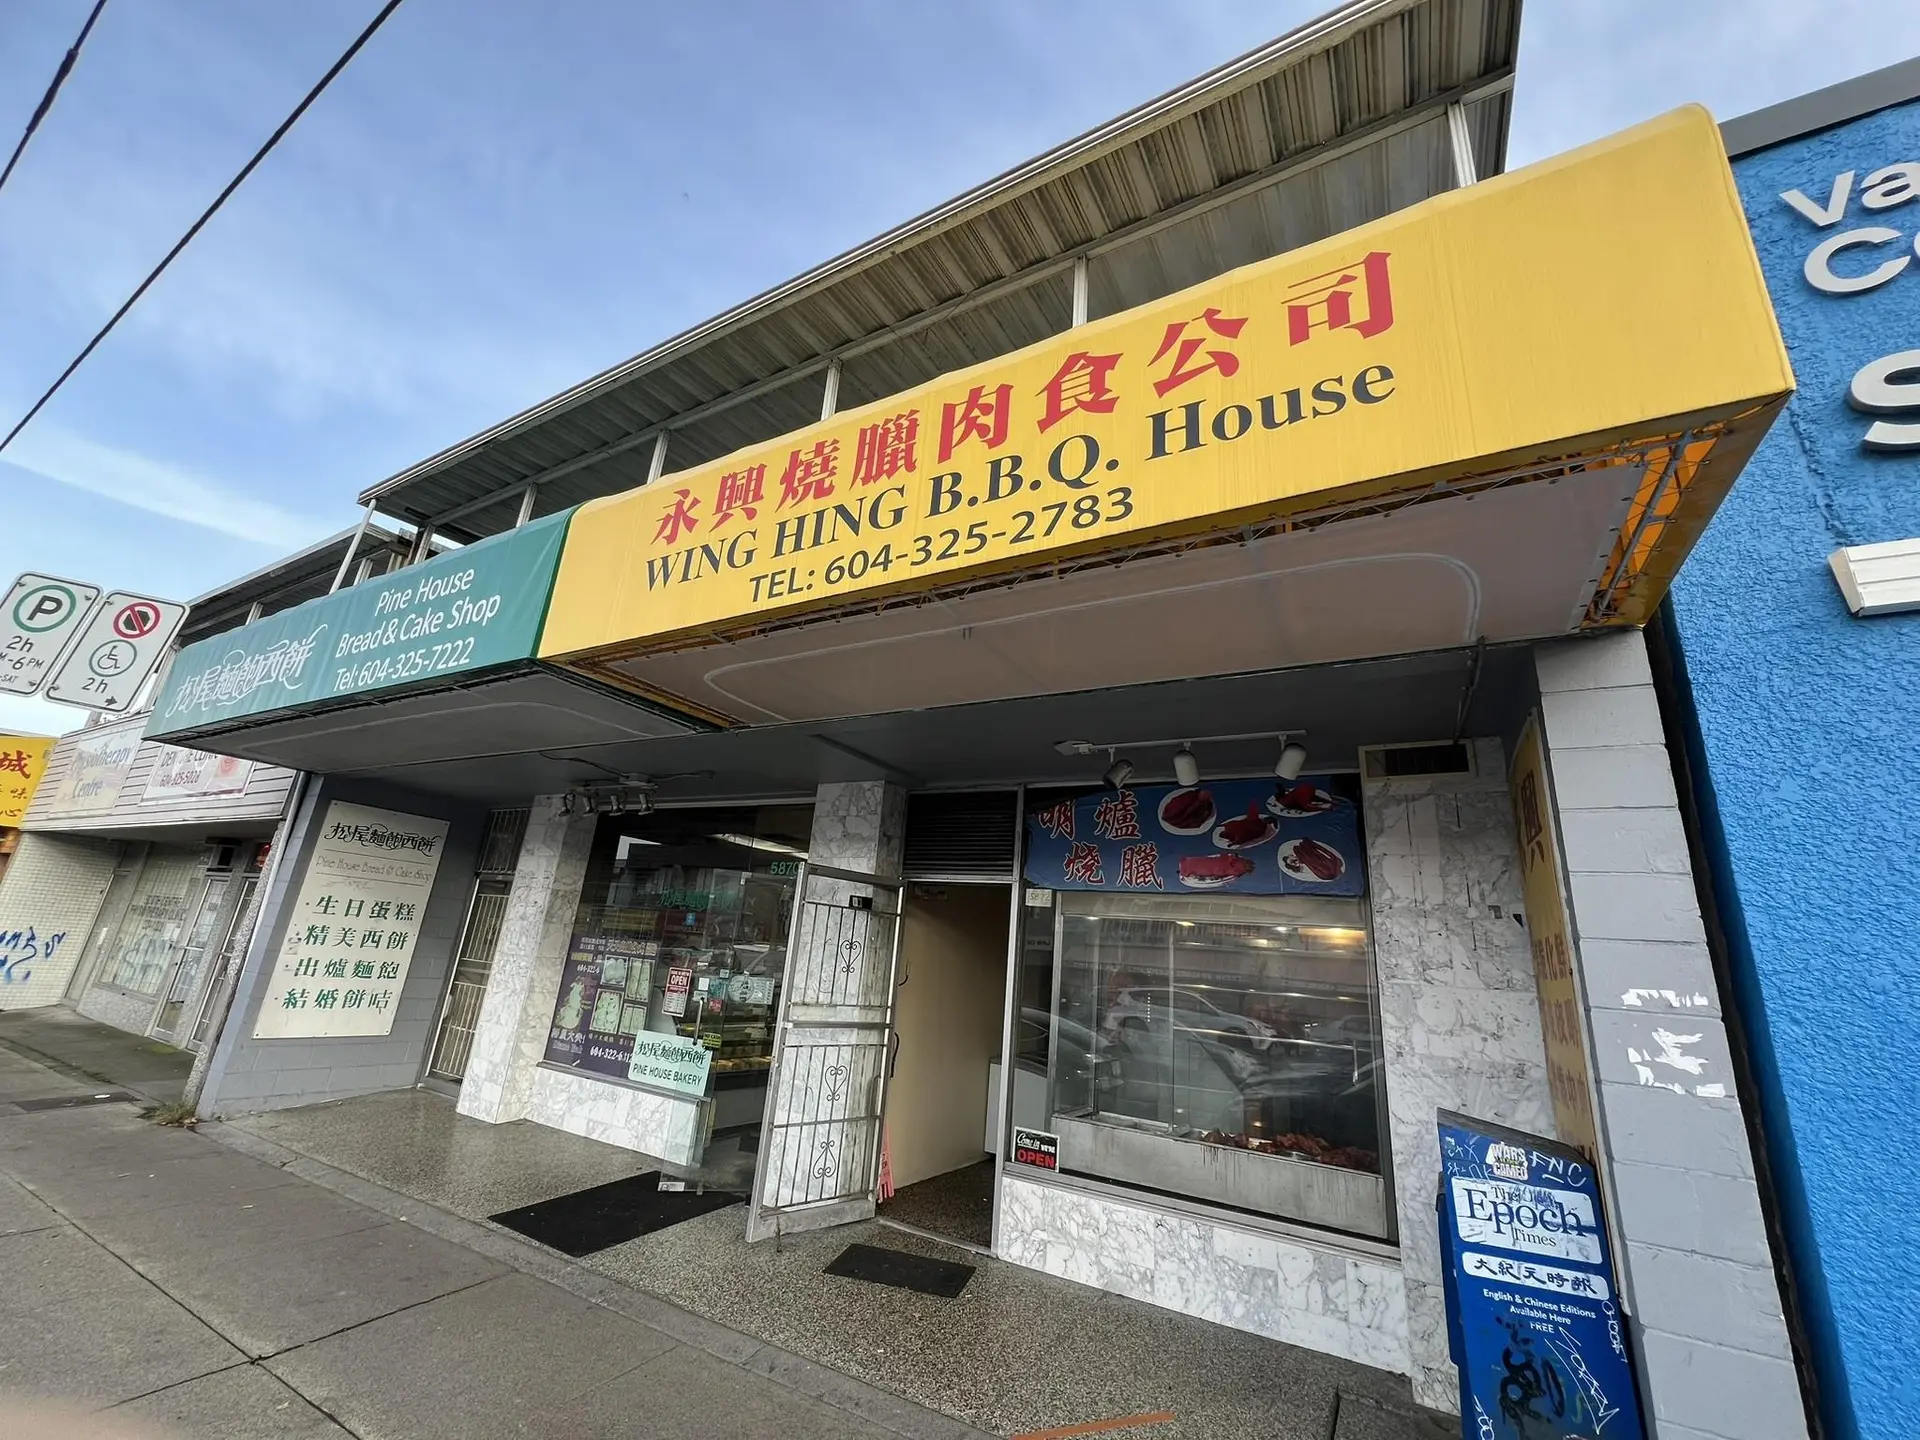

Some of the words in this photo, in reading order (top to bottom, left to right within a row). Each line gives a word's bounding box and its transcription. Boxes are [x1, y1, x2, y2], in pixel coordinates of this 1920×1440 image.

[1804, 227, 1920, 293] C
[651, 252, 1394, 546] 永興燒臘肉食公司
[645, 529, 758, 592] WING
[771, 484, 908, 559] HING
[924, 434, 1119, 519] B.B.Q.
[1145, 364, 1396, 461] House
[750, 569, 815, 603] TEL:
[825, 486, 1134, 585] 604-325-2783
[374, 588, 412, 617] Pine
[415, 568, 475, 605] House
[447, 594, 501, 629] Shop
[5, 635, 34, 653] 2h
[81, 677, 109, 694] 2h
[312, 895, 416, 921] 生日蛋糕
[303, 924, 409, 951] 精美西餅
[670, 974, 688, 986] OPEN
[633, 1063, 648, 1076] PINE
[649, 1066, 672, 1080] HOUSE
[673, 1071, 703, 1086] BAKERY
[1017, 1149, 1055, 1169] OPEN
[1462, 1187, 1588, 1238] Epoch
[1513, 1226, 1557, 1247] Times
[1483, 1288, 1513, 1303] English
[1515, 1295, 1522, 1304] &
[1524, 1297, 1559, 1312] Chinese
[1560, 1304, 1597, 1319] Editions
[1510, 1305, 1548, 1320] Available
[1549, 1313, 1571, 1325] Here
[1530, 1321, 1555, 1334] FREE
